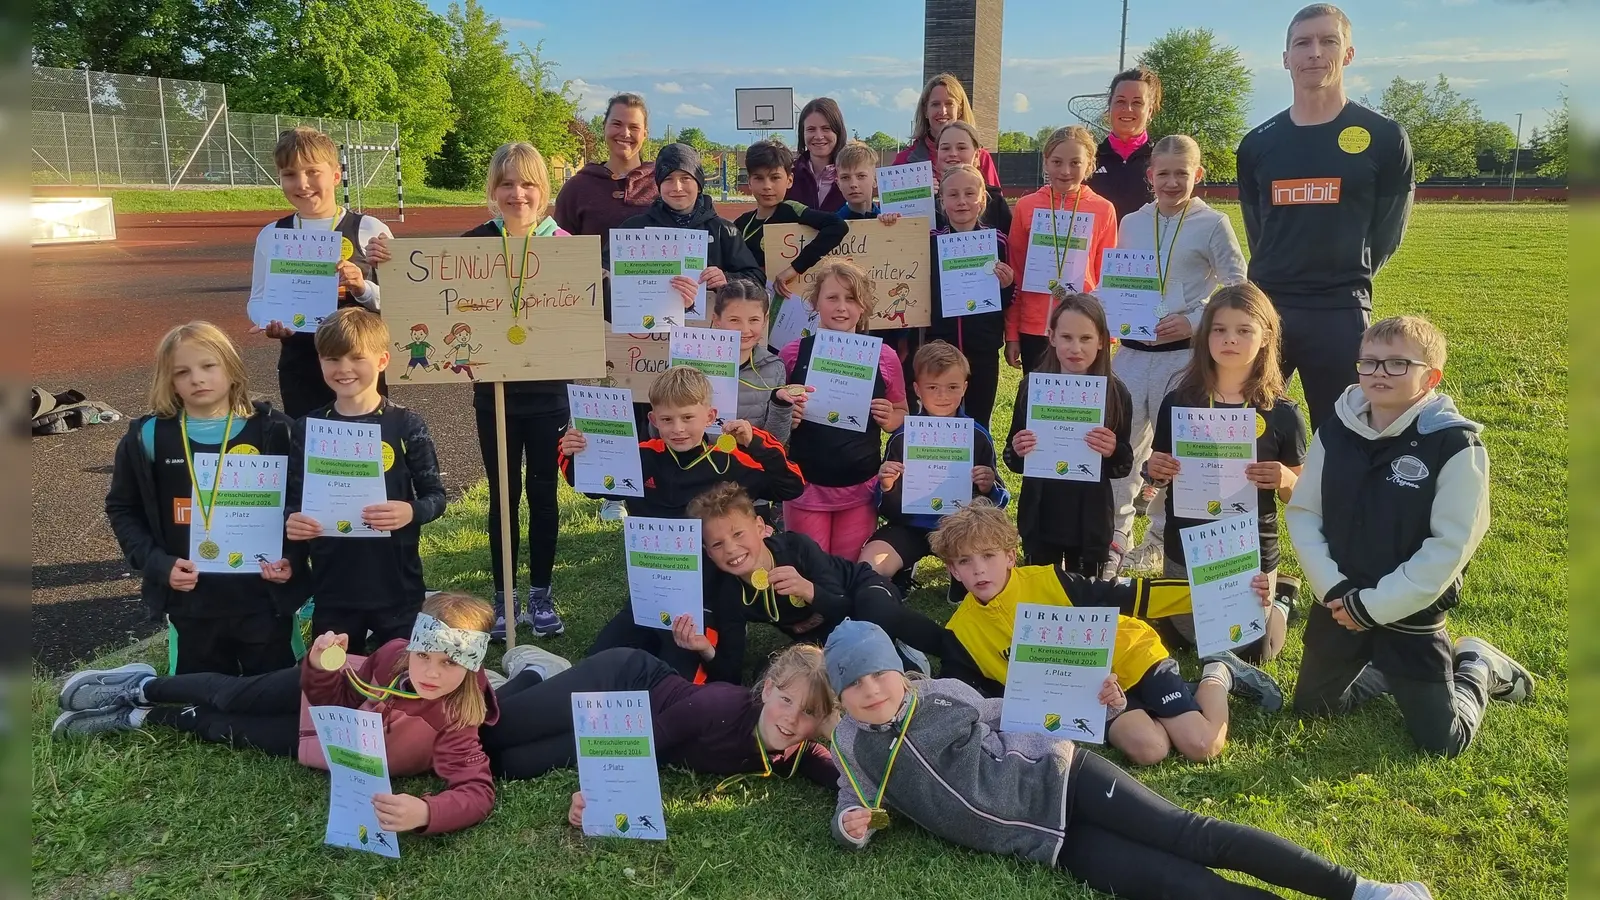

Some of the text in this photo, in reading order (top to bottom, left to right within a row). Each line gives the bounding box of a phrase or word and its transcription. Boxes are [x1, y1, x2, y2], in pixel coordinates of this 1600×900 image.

[1274, 182, 1338, 203] indibit
[274, 233, 336, 242] URKUNDE
[942, 233, 992, 244] URKUNDE
[780, 234, 868, 258] Stwald
[407, 250, 540, 282] STEINWALD
[906, 261, 919, 280] 2
[440, 288, 504, 316] Power
[586, 282, 596, 306] 1
[674, 332, 735, 342] URKUNDE
[821, 334, 876, 348] URKUNDE
[1036, 378, 1101, 388] URKUNDE
[572, 390, 628, 402] URKUNDE
[1178, 412, 1248, 421] URKUNDE
[311, 424, 374, 438] URKUNDE
[910, 421, 968, 429] URKUNDE
[630, 522, 696, 532] URKUNDE
[1188, 518, 1253, 542] URKUNDE
[1024, 610, 1111, 622] URKUNDE
[1038, 648, 1098, 656] Kreisschülerrunde
[1028, 655, 1061, 664] Oberpfalz
[578, 698, 644, 709] URKUNDE
[1161, 691, 1182, 704] JAKO
[318, 712, 376, 729] URKUNDE
